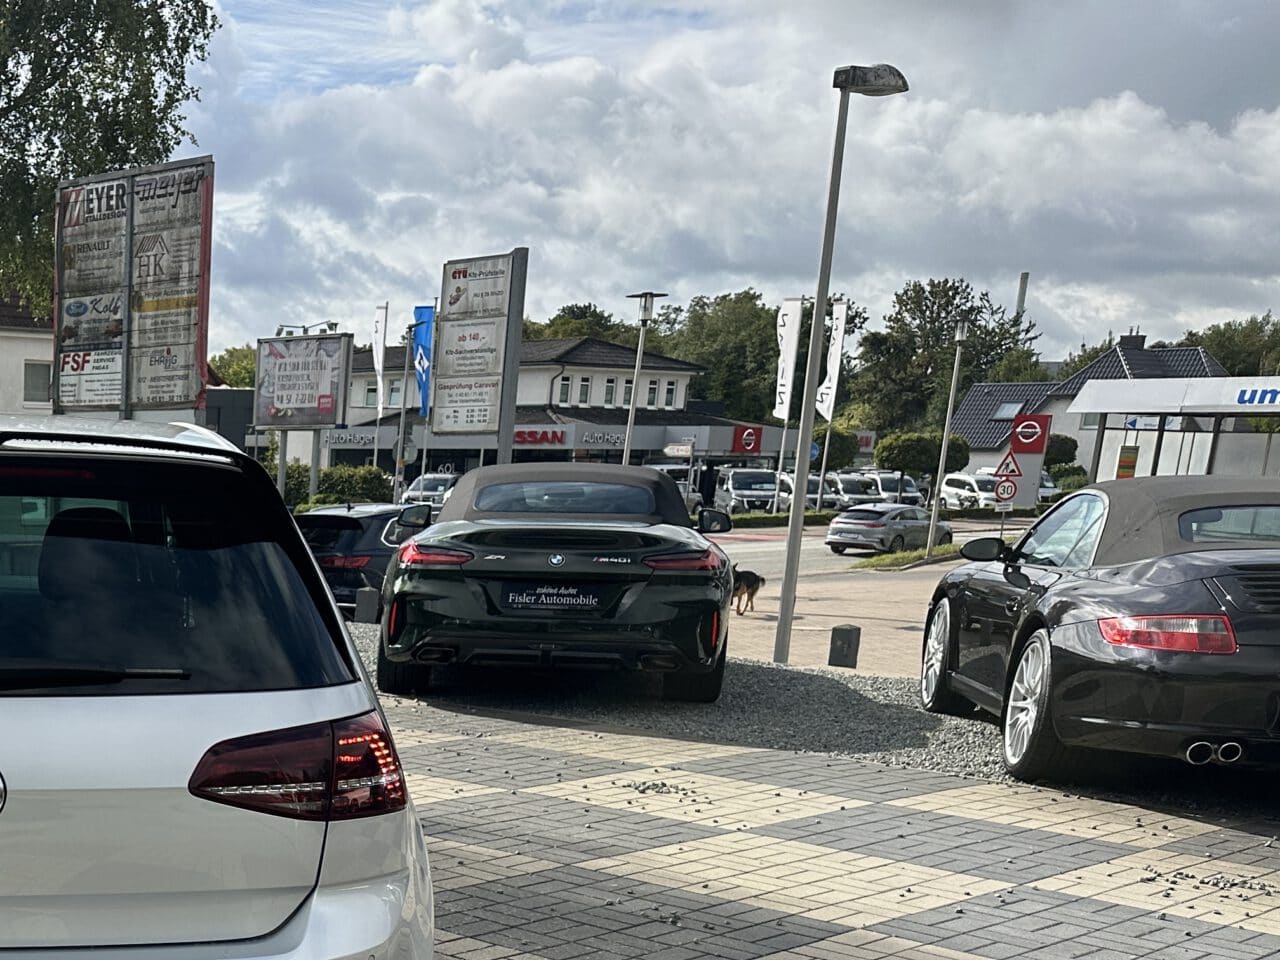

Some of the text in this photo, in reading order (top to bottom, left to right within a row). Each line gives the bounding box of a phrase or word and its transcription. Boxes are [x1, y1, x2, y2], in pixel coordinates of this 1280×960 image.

[61, 352, 91, 373] FSF
[438, 382, 473, 391] Gasprüfung
[583, 432, 603, 443] Auto
[1000, 484, 1013, 496] 30
[508, 593, 598, 606] Fisler Automobile
